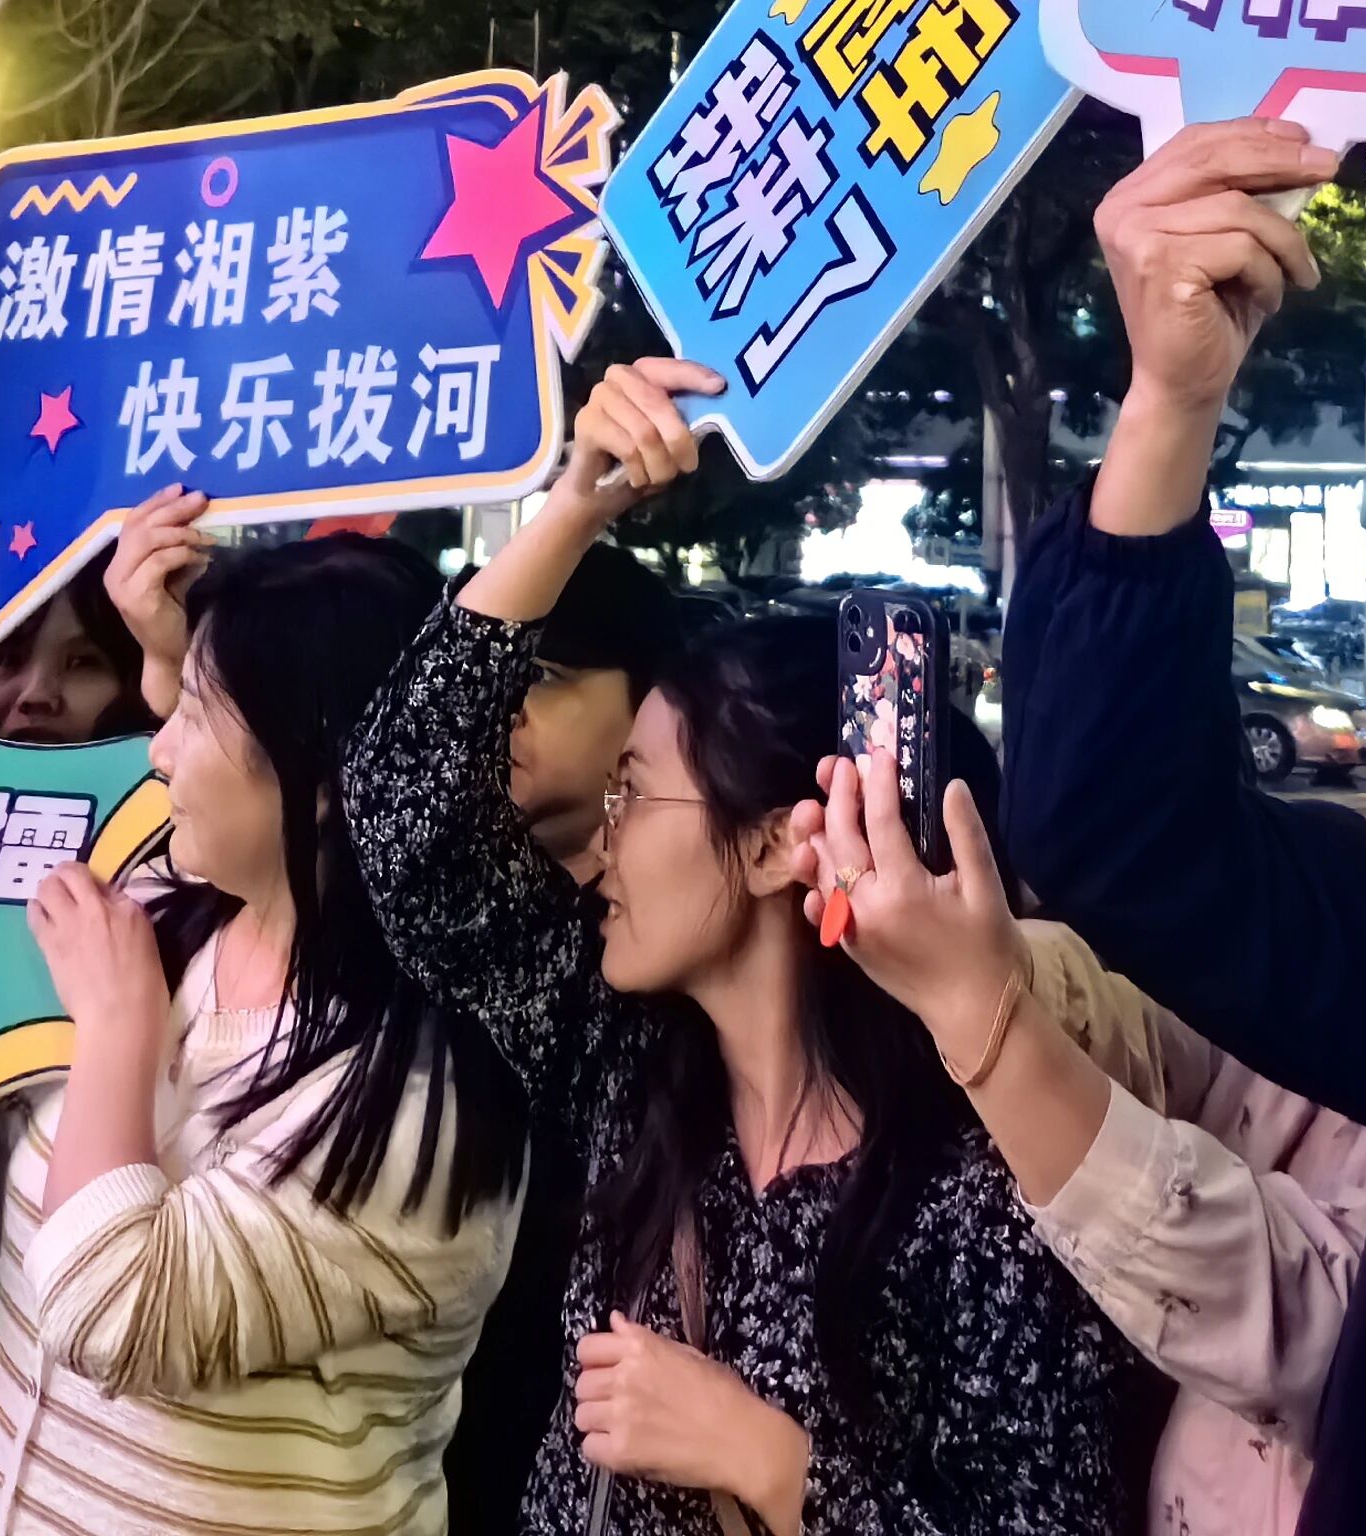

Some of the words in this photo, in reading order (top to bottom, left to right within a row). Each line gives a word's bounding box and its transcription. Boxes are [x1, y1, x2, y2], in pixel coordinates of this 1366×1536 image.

[646, 28, 897, 398] 我来了
[117, 343, 501, 477] 快乐拨河
